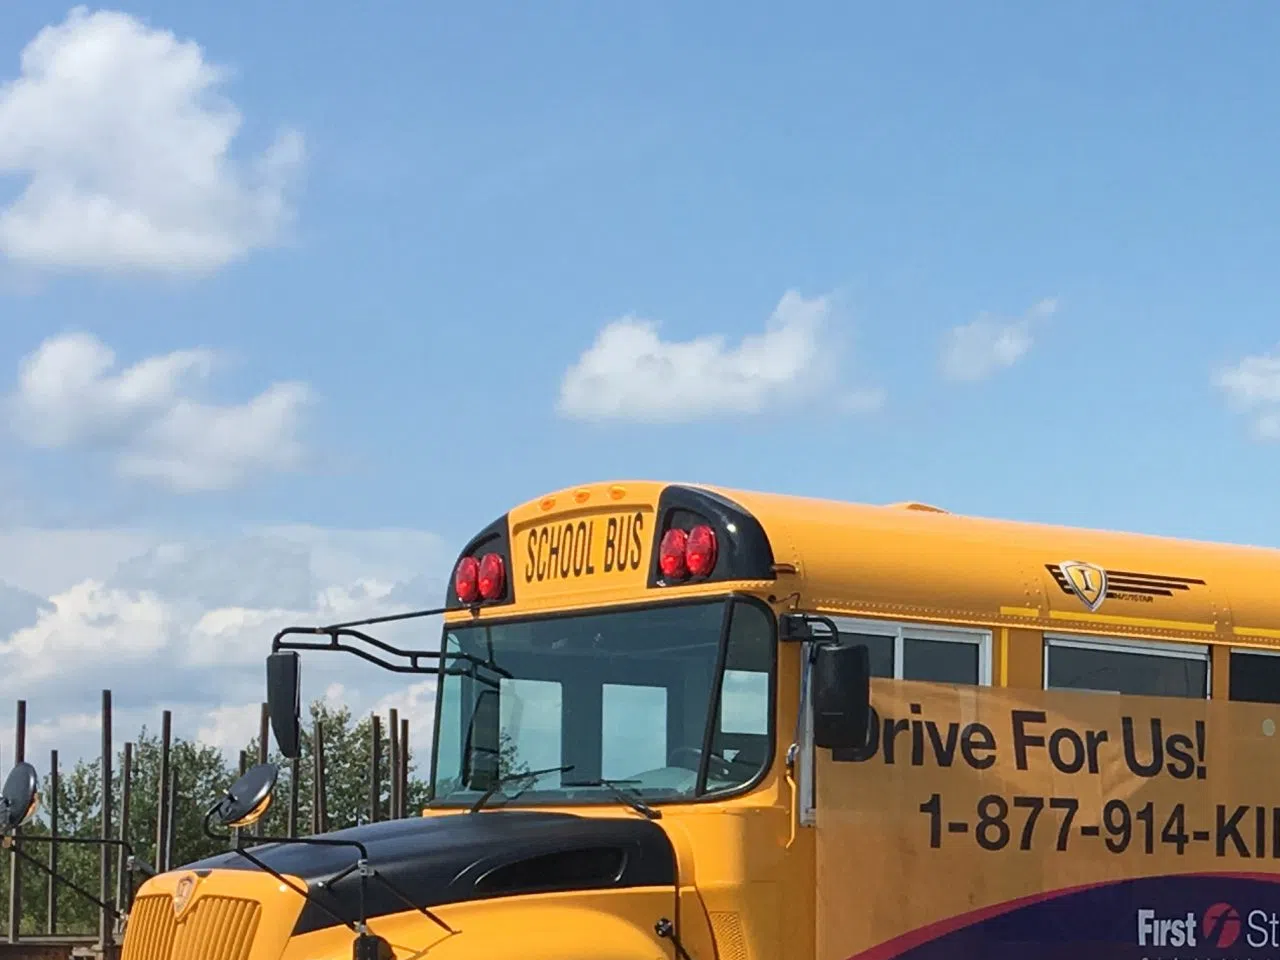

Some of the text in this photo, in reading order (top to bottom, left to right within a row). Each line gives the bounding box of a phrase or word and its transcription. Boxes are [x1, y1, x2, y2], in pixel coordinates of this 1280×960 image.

[525, 511, 644, 583] SCHOOL BUS
[1011, 709, 1108, 774] For
[1122, 716, 1207, 780] Us!
[1138, 909, 1197, 947] First
